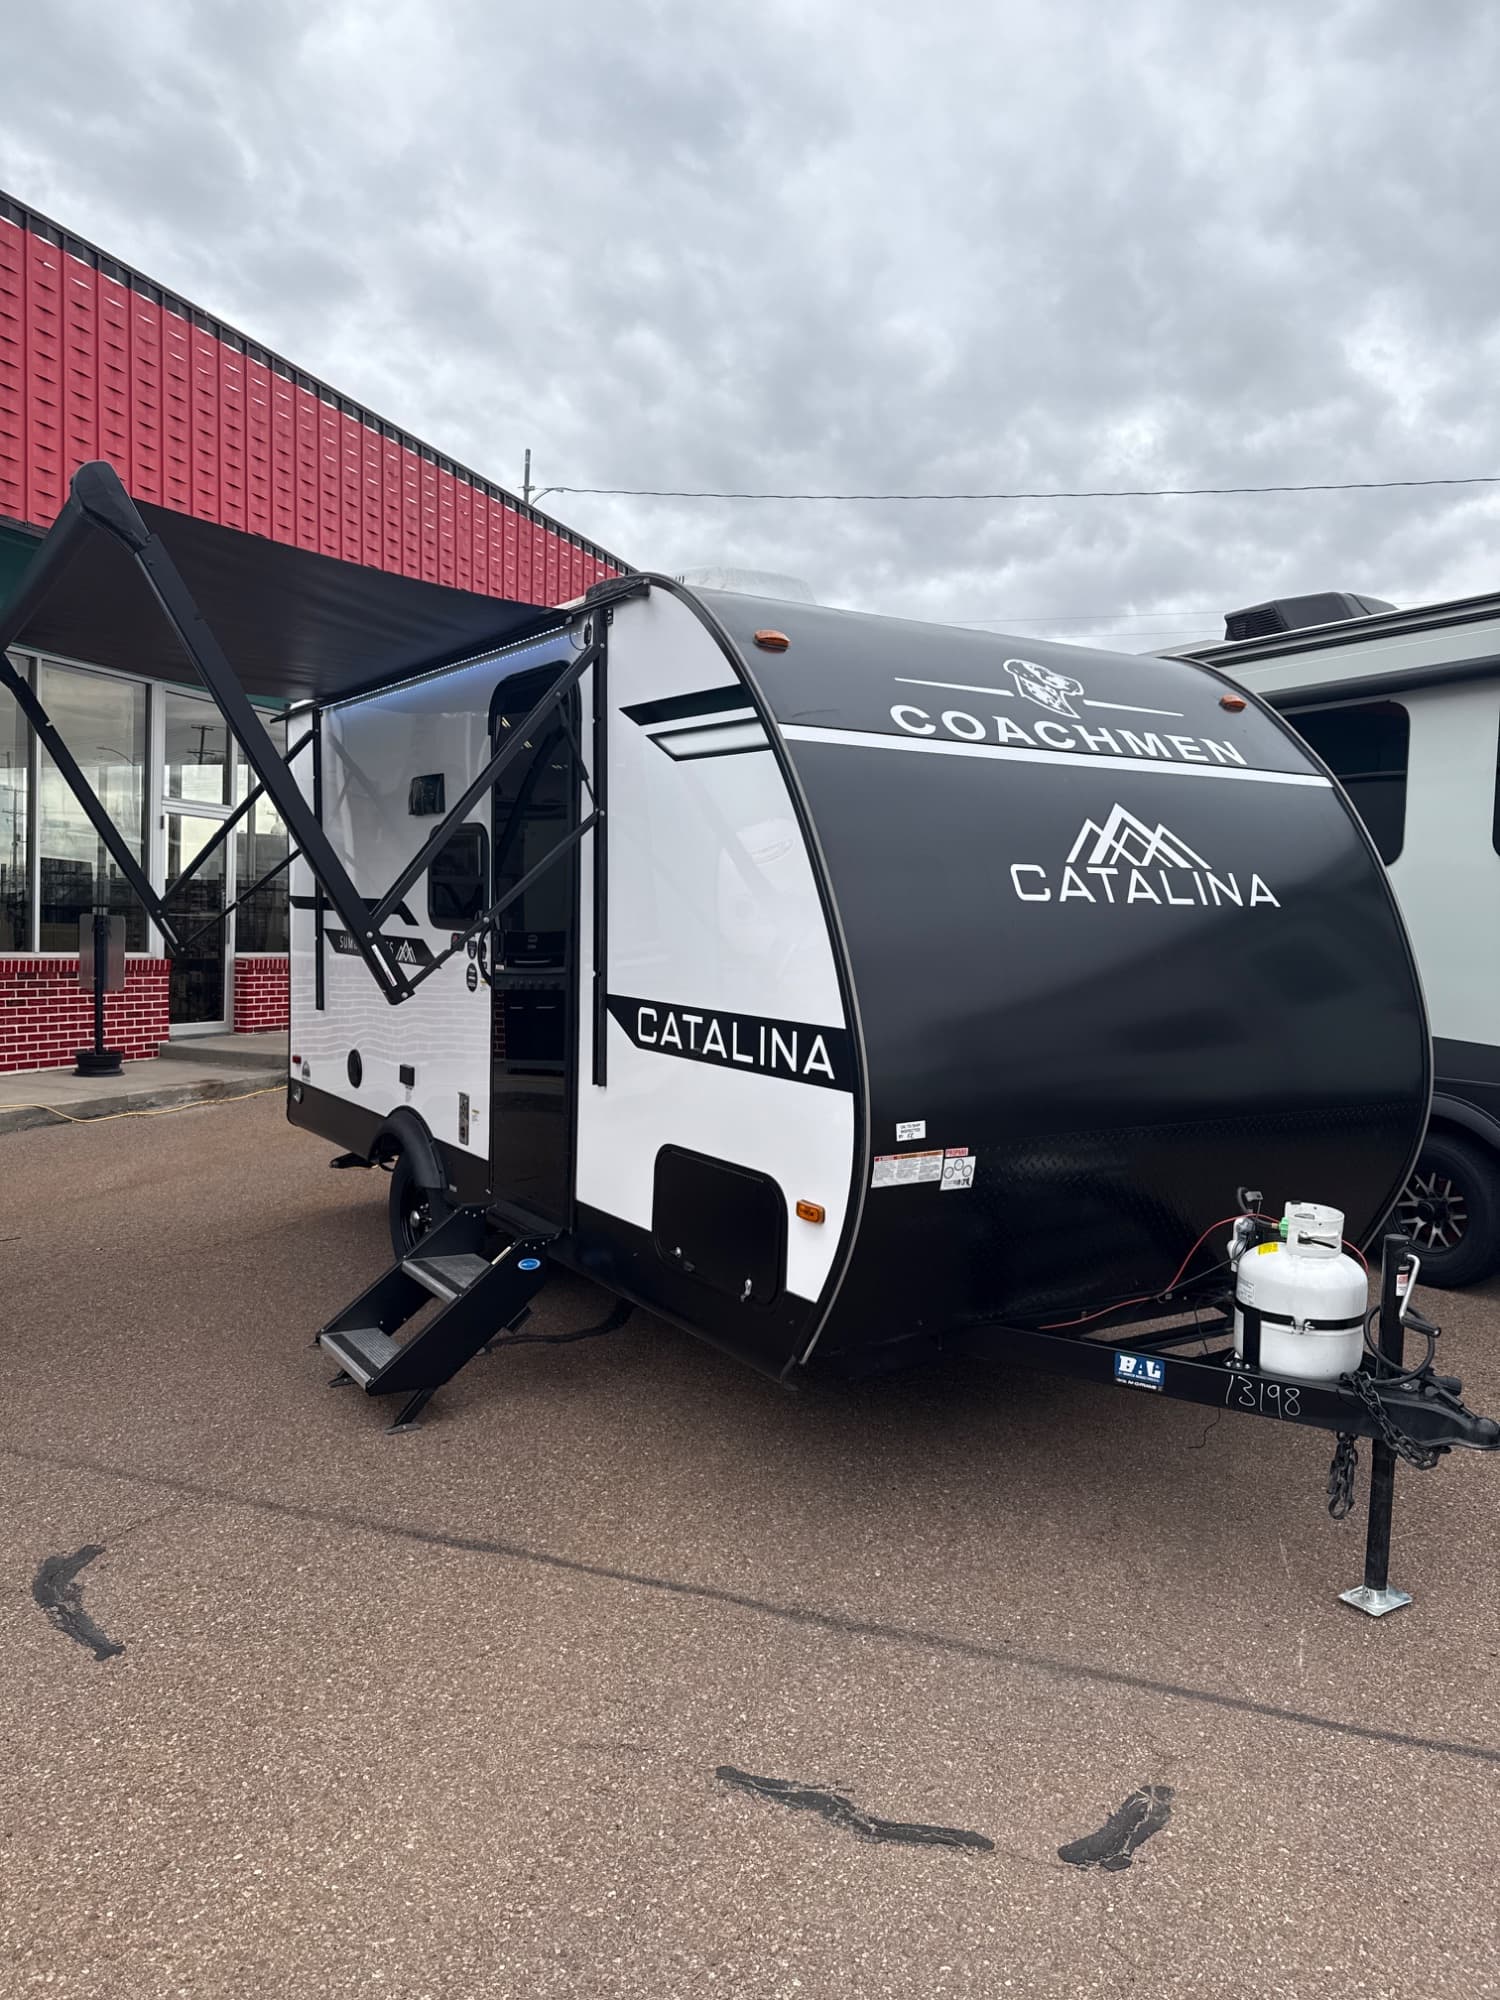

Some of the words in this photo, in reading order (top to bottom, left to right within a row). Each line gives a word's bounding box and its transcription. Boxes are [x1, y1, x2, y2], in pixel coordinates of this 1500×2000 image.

[889, 704, 1248, 766] COACHMEN
[1010, 863, 1281, 908] CATALINA
[637, 1006, 835, 1080] CATALINA
[1119, 1355, 1161, 1379] BAL
[1226, 1374, 1301, 1419] 13198
